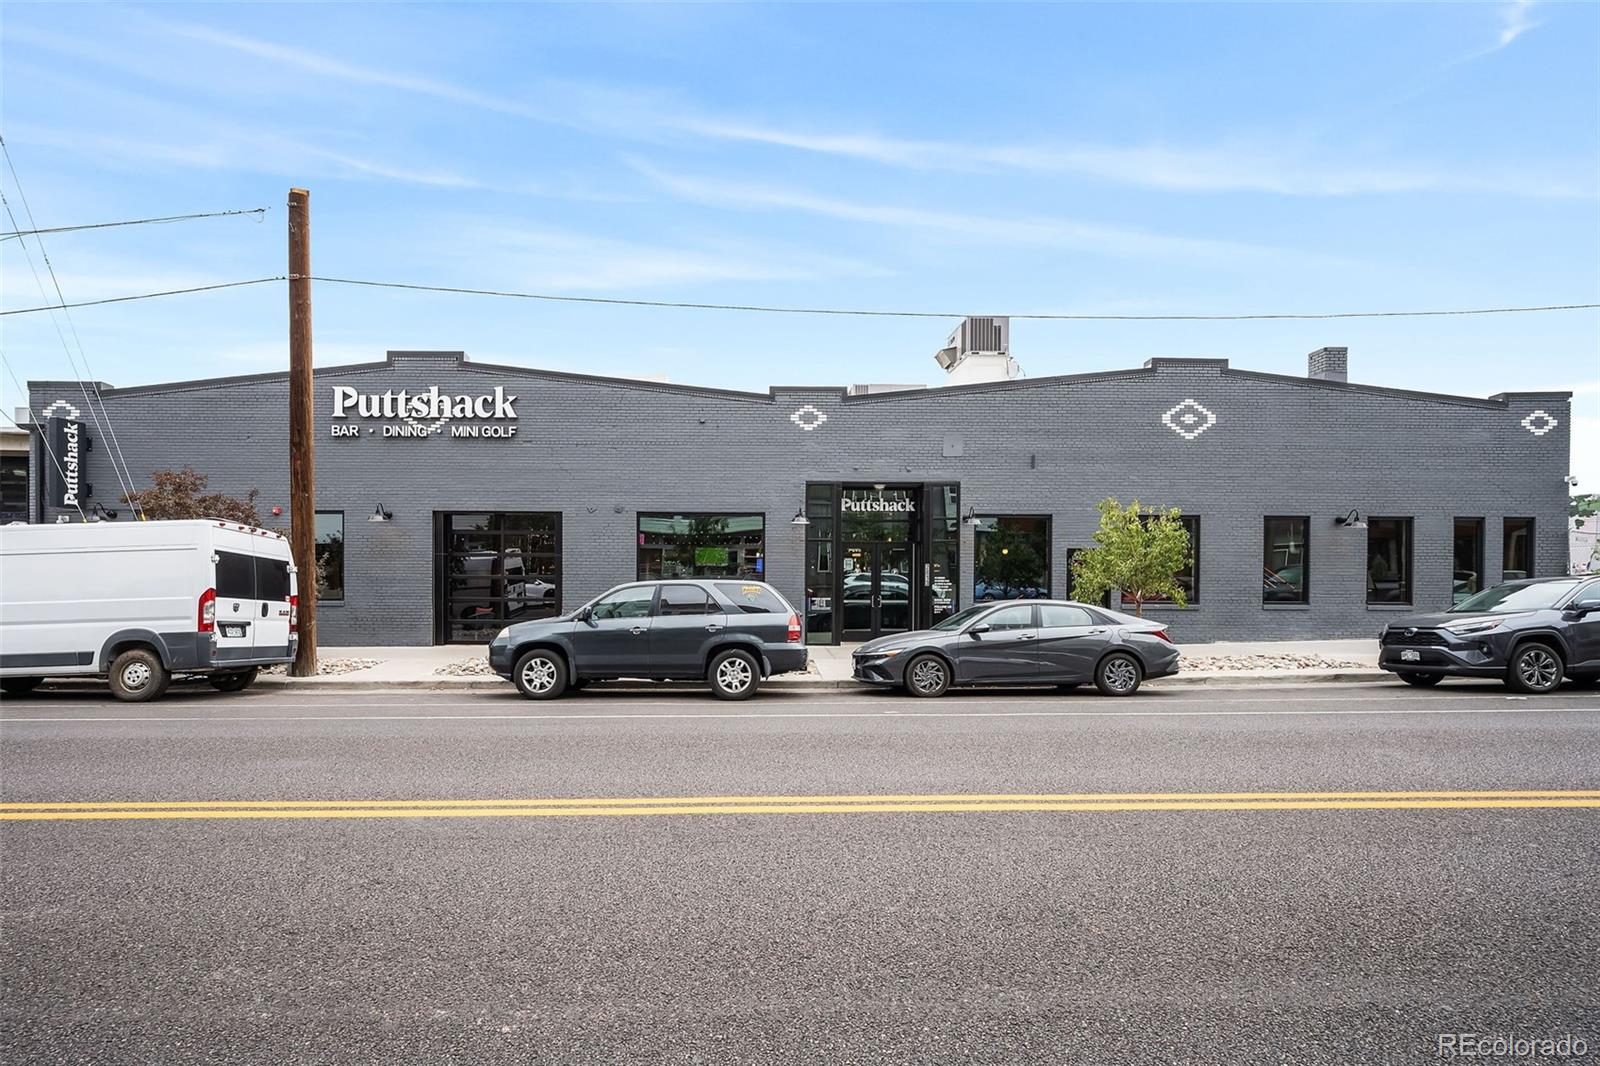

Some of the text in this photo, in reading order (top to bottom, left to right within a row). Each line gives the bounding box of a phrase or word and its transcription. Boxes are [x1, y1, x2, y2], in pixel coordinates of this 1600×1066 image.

[331, 385, 518, 419] Puttshack
[331, 425, 517, 438] BAR DINING MINI GOLF
[63, 422, 79, 506] Puttshack
[841, 498, 916, 512] Puttshack
